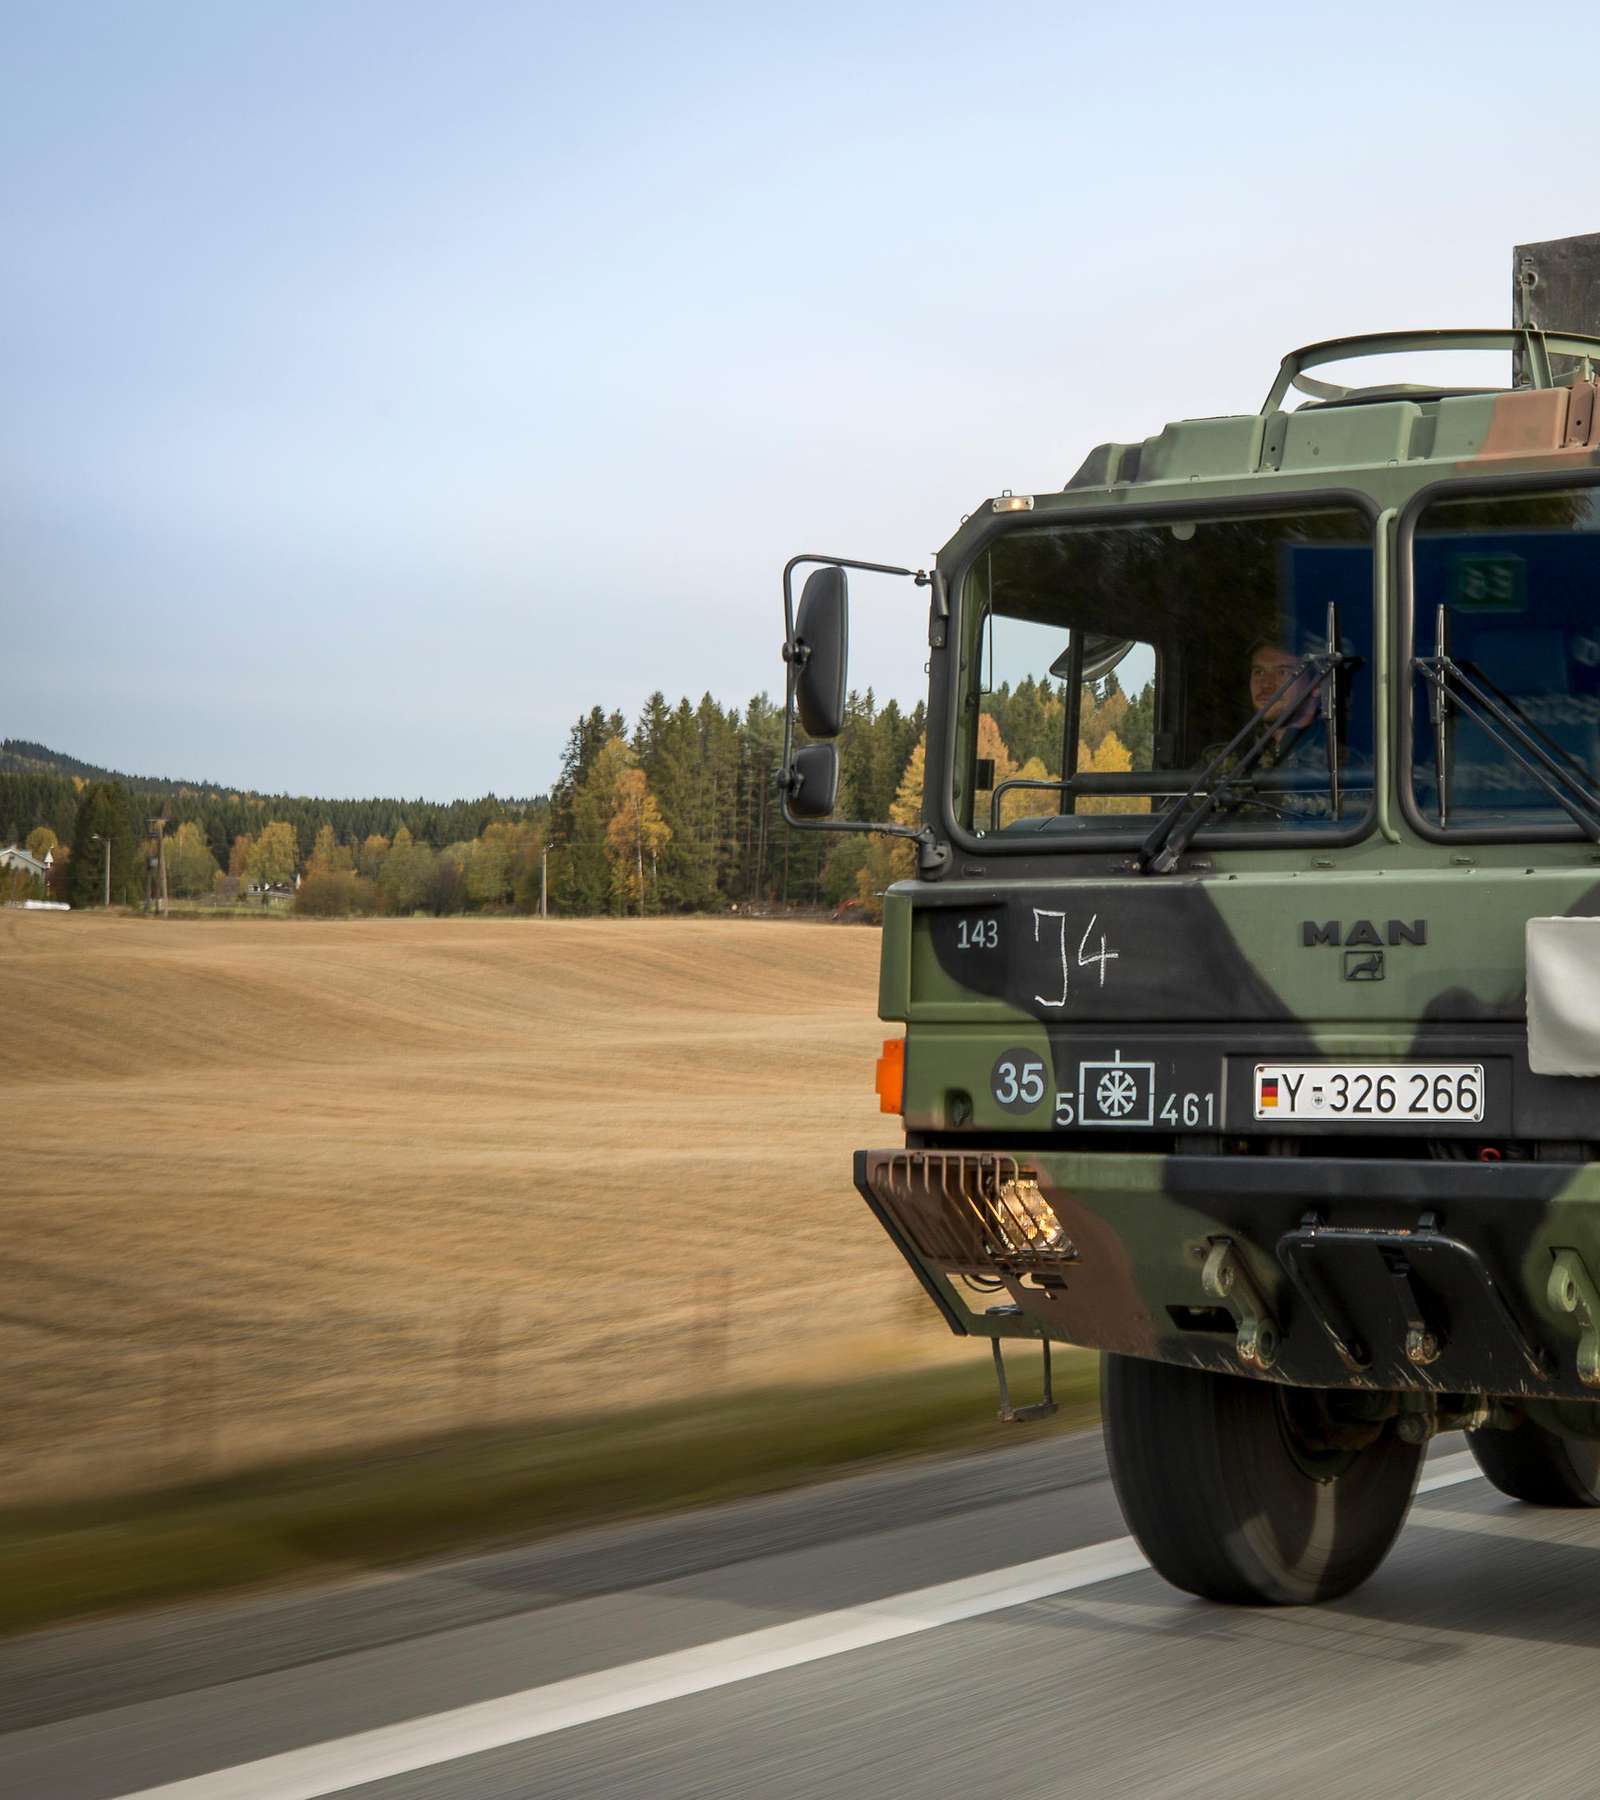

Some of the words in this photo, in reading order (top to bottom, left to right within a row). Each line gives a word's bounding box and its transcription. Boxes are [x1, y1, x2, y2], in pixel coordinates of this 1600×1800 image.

[957, 919, 999, 949] 143
[1303, 919, 1427, 947] MAN
[995, 1062, 1045, 1105] 35
[1408, 1073, 1478, 1113] 266
[1055, 1092, 1075, 1126] 5
[1159, 1092, 1214, 1127] 461
